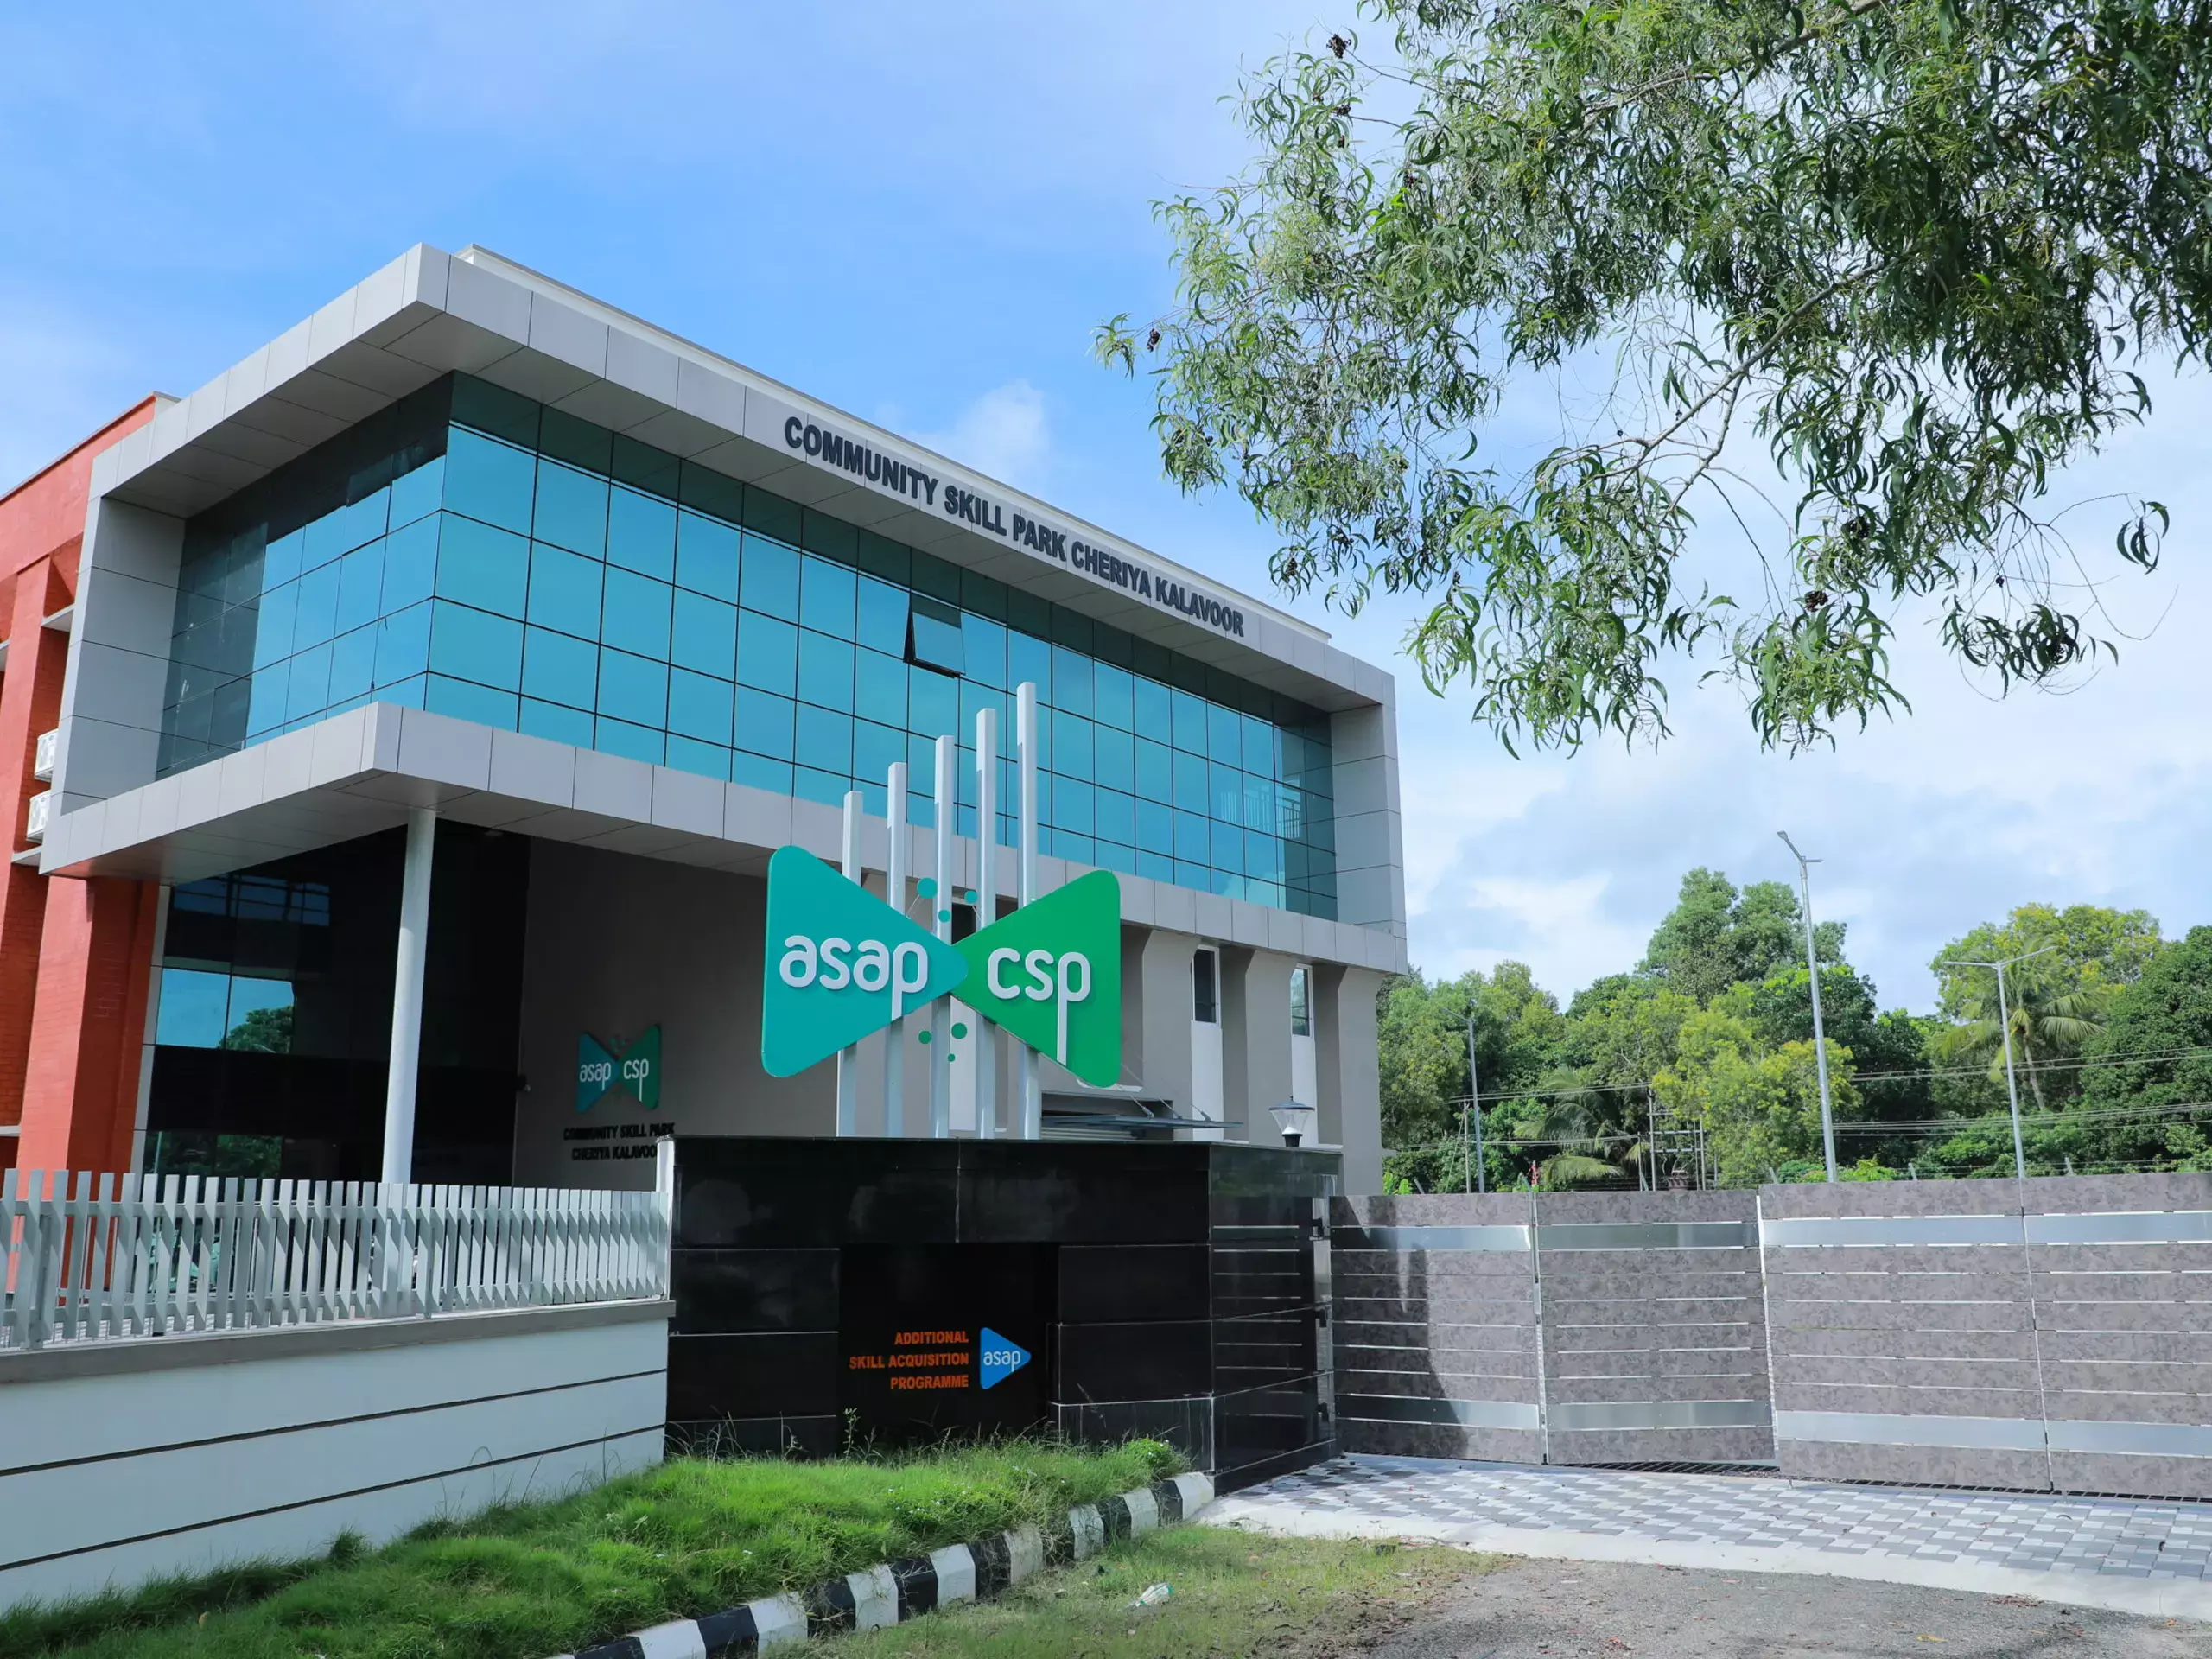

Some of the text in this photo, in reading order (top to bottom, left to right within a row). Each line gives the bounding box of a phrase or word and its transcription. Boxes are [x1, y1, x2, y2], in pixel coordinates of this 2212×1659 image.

[785, 416, 1245, 637] COMMUNITY SKILL PARK CHERIYA KALAVOOR
[779, 935, 928, 1020] asap
[987, 947, 1090, 1066] csp
[579, 1062, 611, 1091] asap
[623, 1058, 649, 1102] csp
[563, 1122, 675, 1141] COMMUNITY SKILL PARK
[612, 1144, 657, 1160] KALAVOO
[894, 1331, 969, 1344] ADDITIONAL
[849, 1352, 969, 1369] SKILL ACQUISITION
[982, 1350, 1021, 1372] asap
[890, 1375, 969, 1389] PROGRAMME
